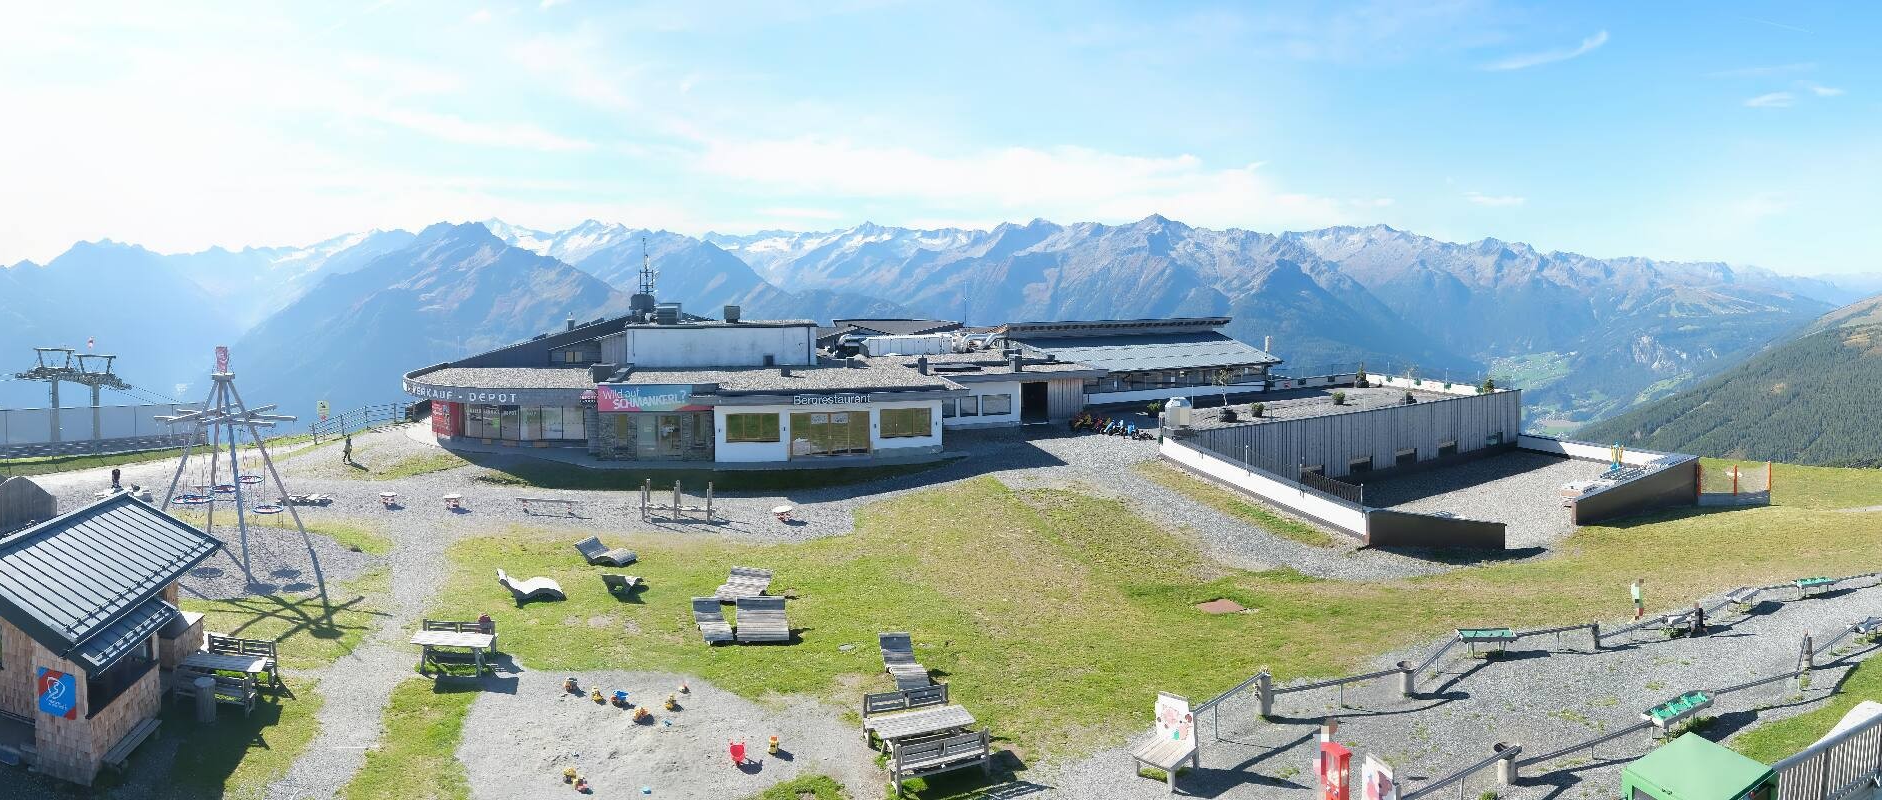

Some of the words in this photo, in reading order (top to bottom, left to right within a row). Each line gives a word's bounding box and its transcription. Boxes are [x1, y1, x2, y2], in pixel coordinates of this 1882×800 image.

[412, 385, 453, 399] VERKAUF
[469, 392, 517, 403] DEPOT
[602, 390, 623, 399] Wild
[625, 388, 640, 398] auf
[613, 390, 686, 409] SCHMANKERL?
[793, 394, 871, 406] Bergrestaurant
